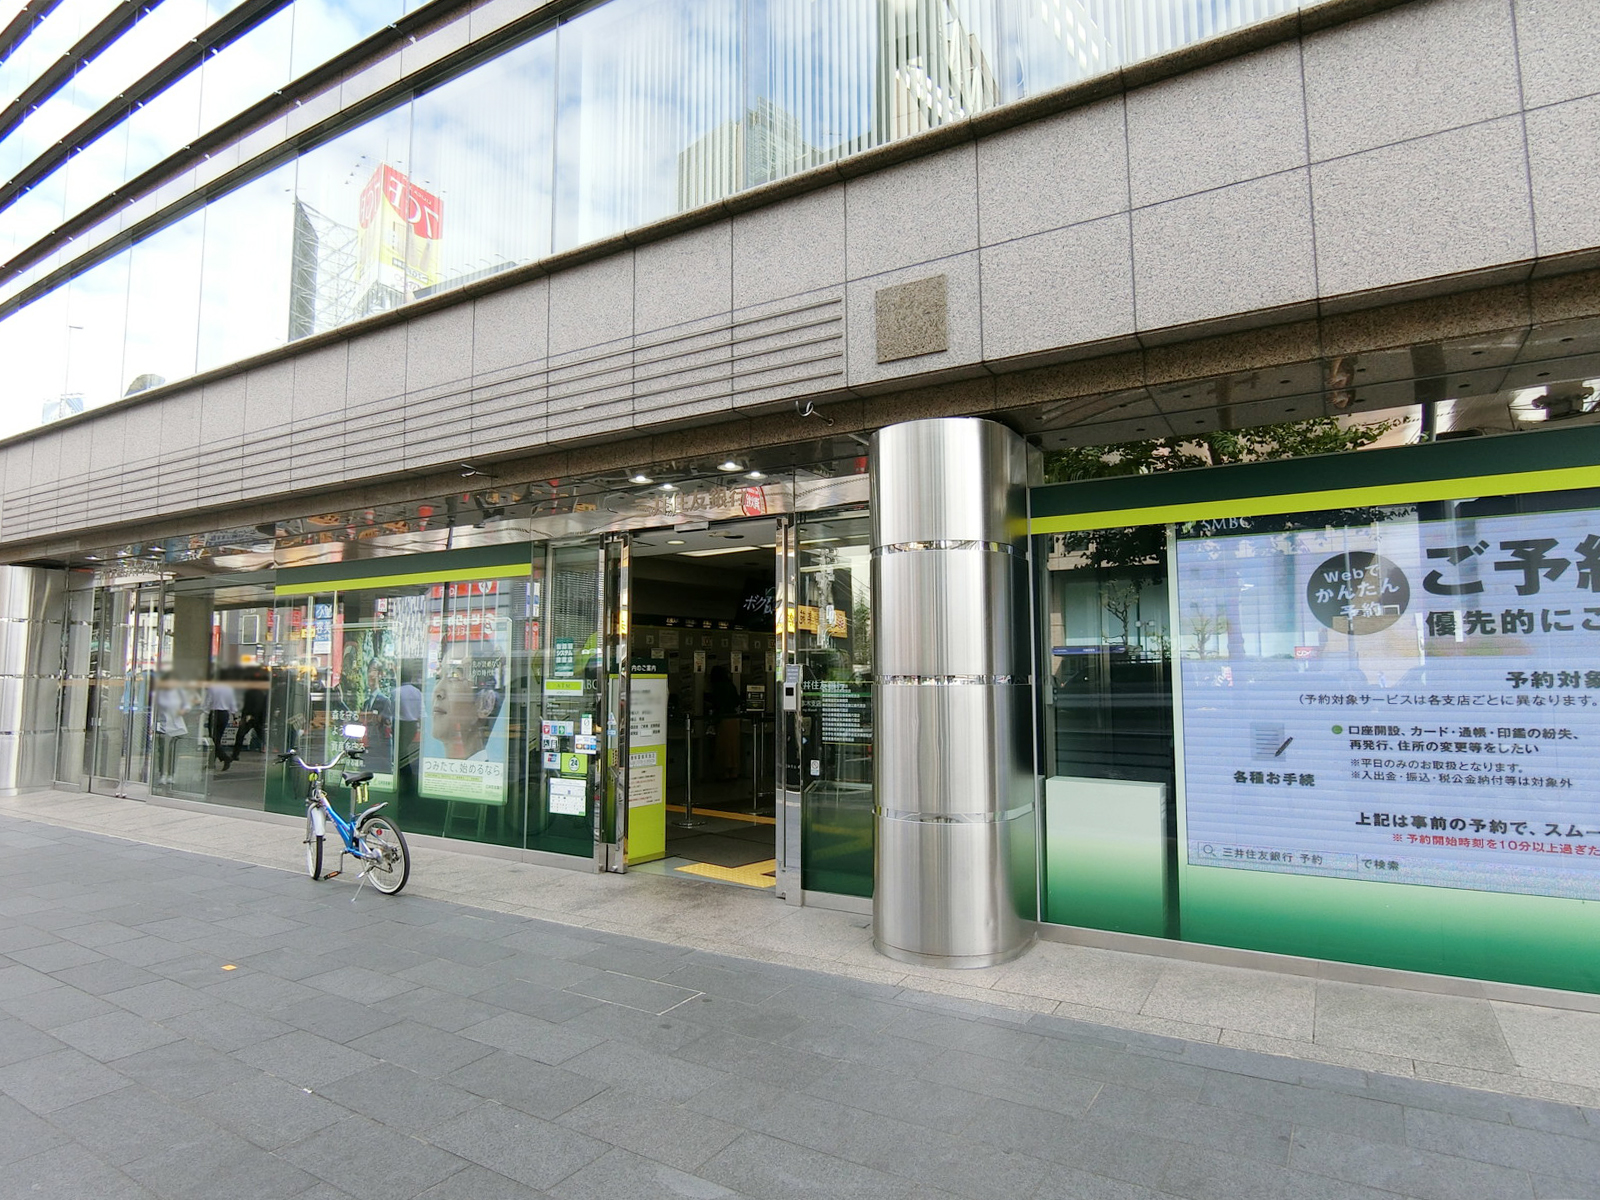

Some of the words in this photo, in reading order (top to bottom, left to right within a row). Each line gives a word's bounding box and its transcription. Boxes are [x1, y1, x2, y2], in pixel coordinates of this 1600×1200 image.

[1323, 563, 1381, 583] Webで
[1315, 578, 1400, 604] かんたん
[1340, 601, 1384, 621] 予約
[1350, 739, 1539, 755] 再発行、住所の変更等をしたい
[1233, 770, 1316, 787] 各種お手続
[1222, 846, 1294, 863] 三井住友銀行
[1299, 853, 1324, 866] 予約
[1361, 858, 1400, 871] で検索
